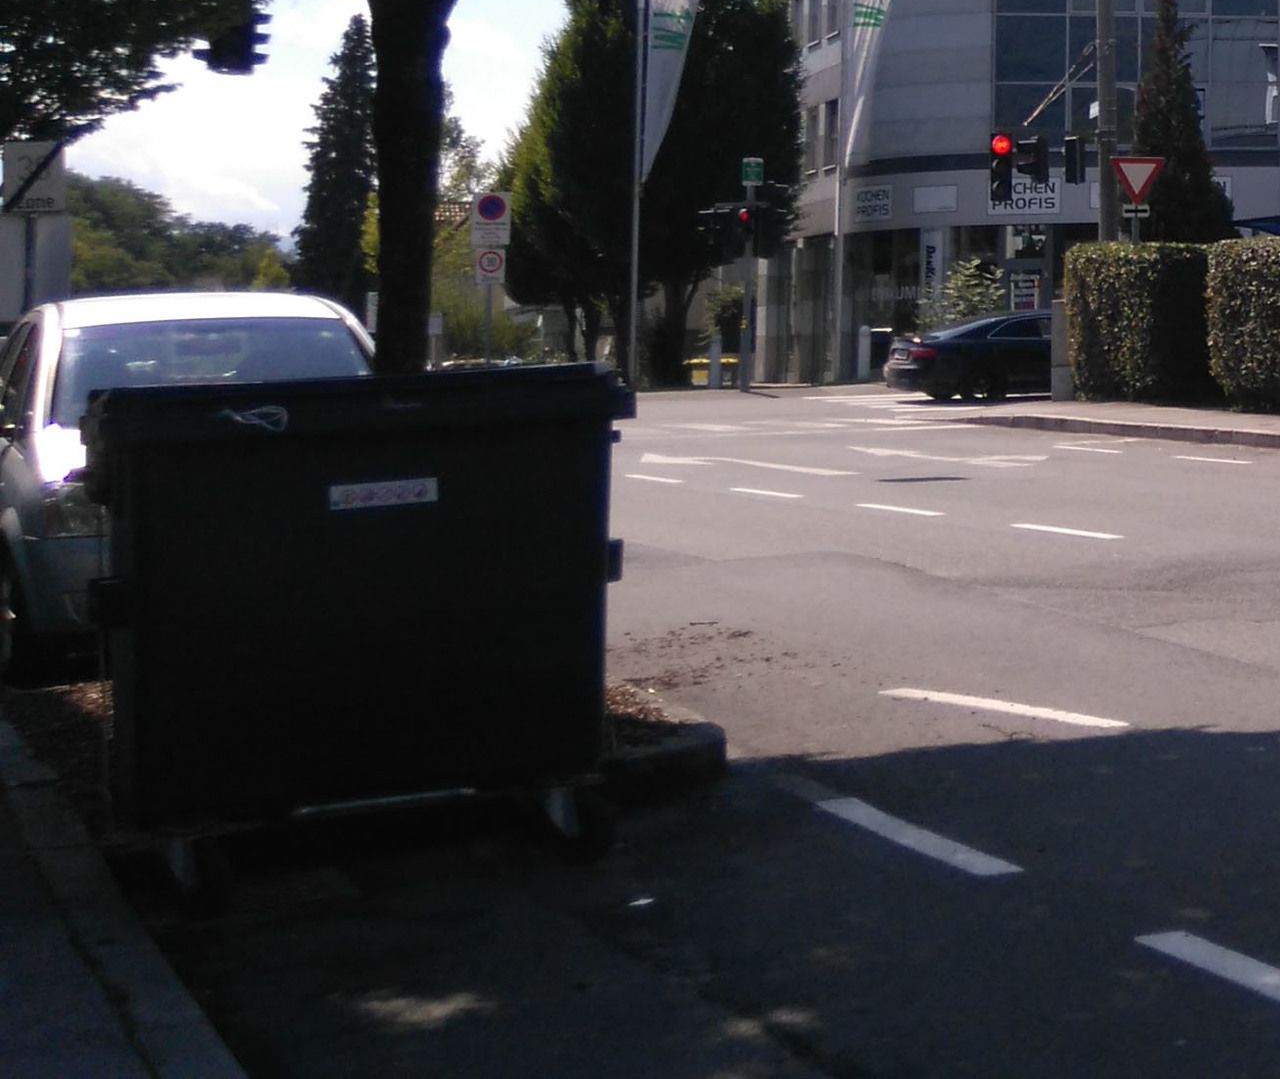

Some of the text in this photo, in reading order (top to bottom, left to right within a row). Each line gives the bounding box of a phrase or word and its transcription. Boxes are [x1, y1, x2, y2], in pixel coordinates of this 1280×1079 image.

[1012, 182, 1056, 195] CHEN
[857, 203, 890, 217] PROFIS
[992, 197, 1056, 211] PROFIS
